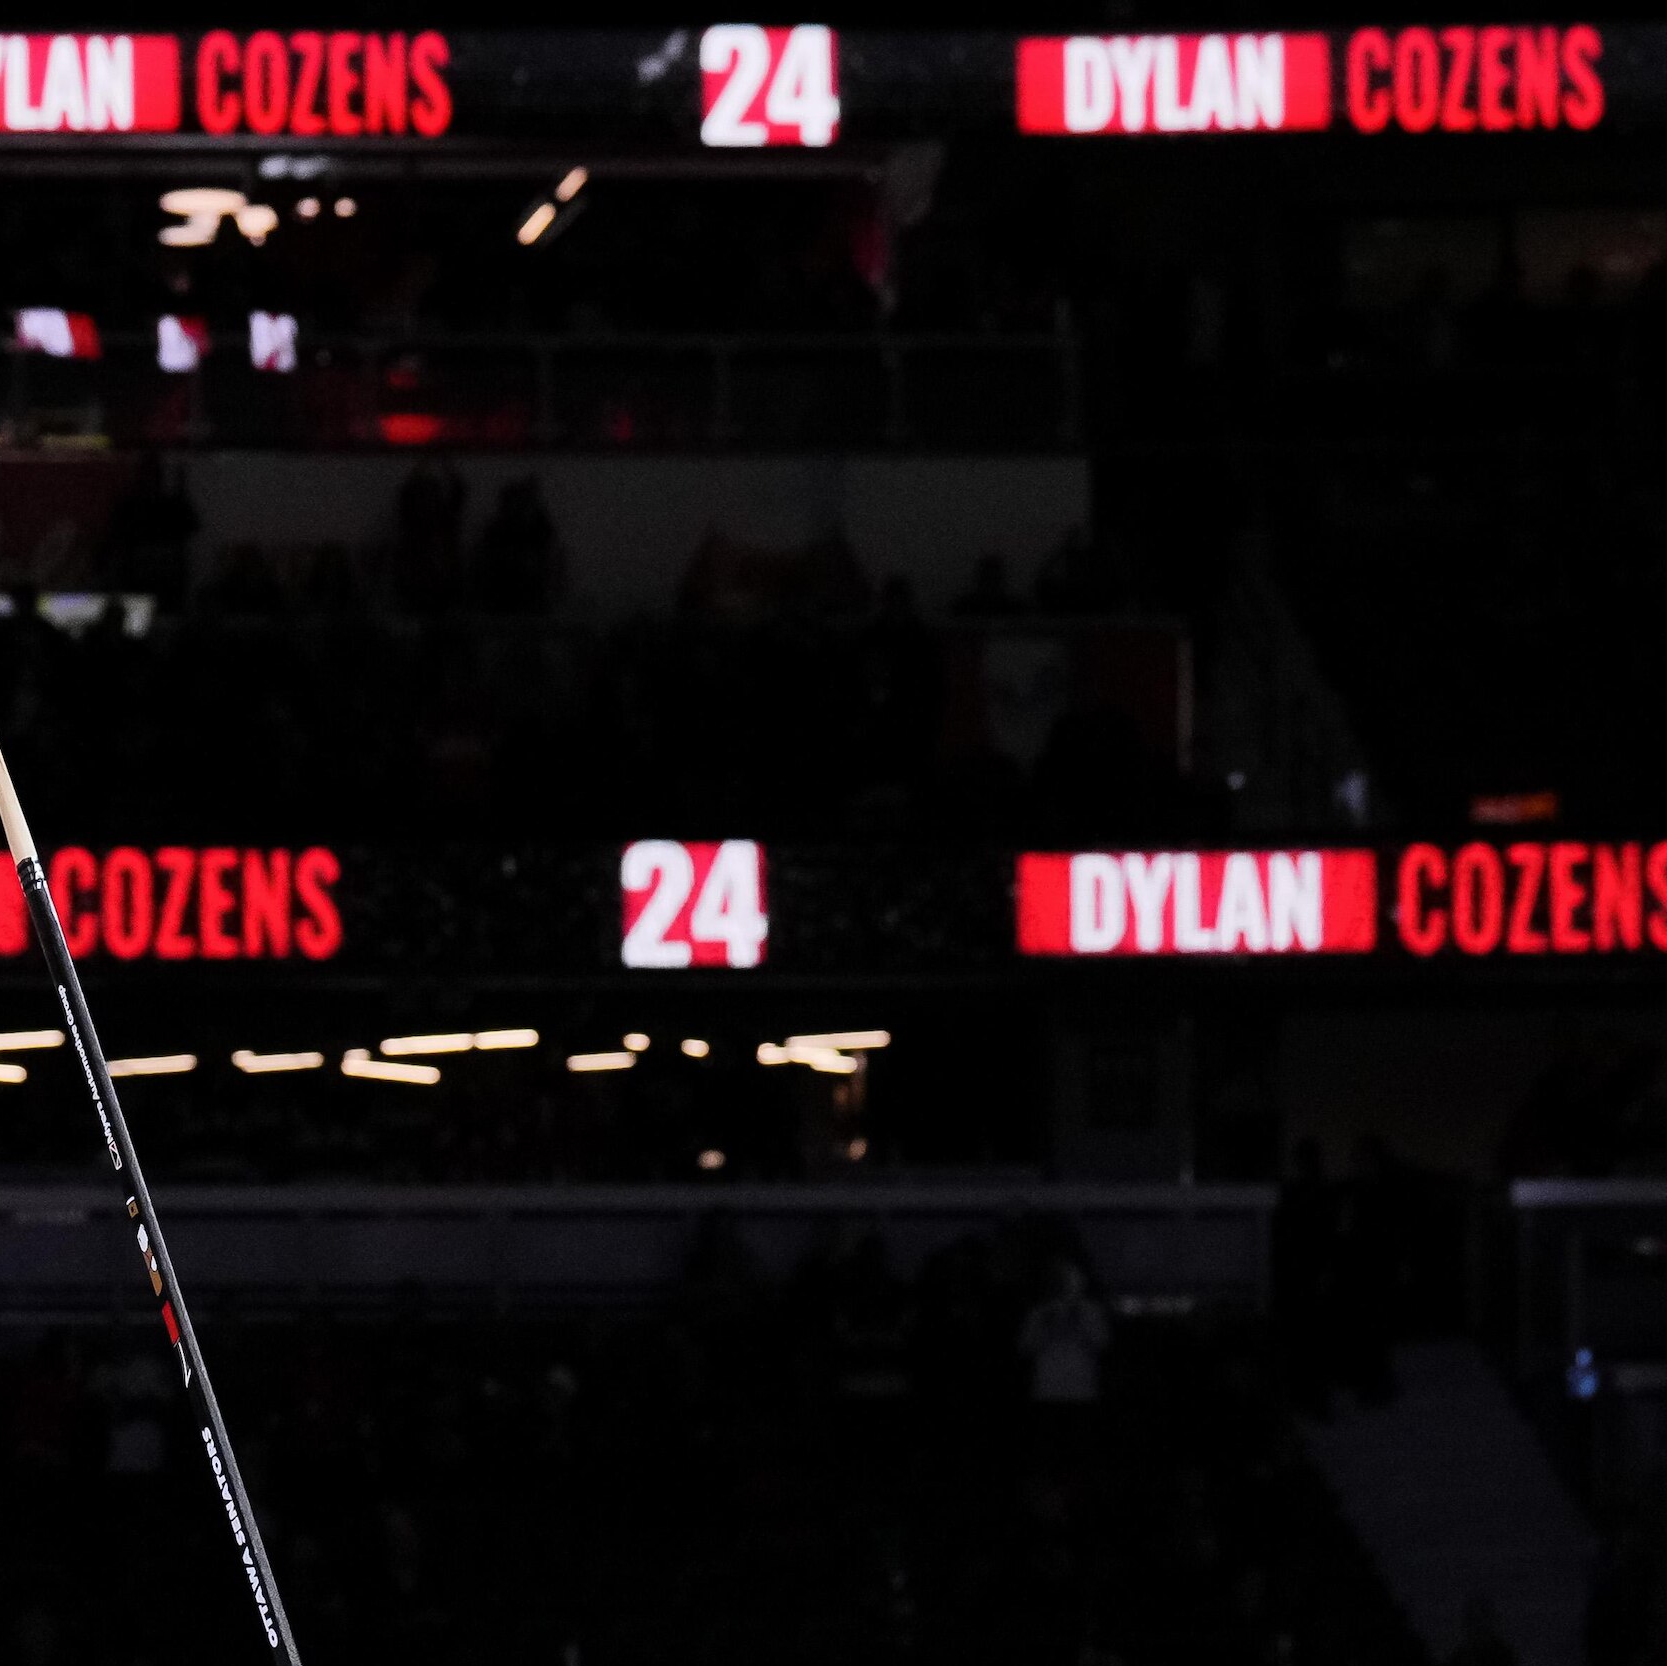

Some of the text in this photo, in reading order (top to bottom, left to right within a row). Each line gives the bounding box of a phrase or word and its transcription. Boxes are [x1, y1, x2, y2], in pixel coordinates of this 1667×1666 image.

[195, 30, 452, 138] COZENS
[699, 25, 840, 147] 24
[1063, 25, 1605, 133] DYLAN COZENS
[51, 847, 342, 958] COZENS
[621, 840, 768, 968] 24
[1070, 852, 1323, 953] DYLAN
[58, 985, 114, 1144] Myers Automotive Group
[201, 1427, 279, 1648] OTTAWA SENATORS
